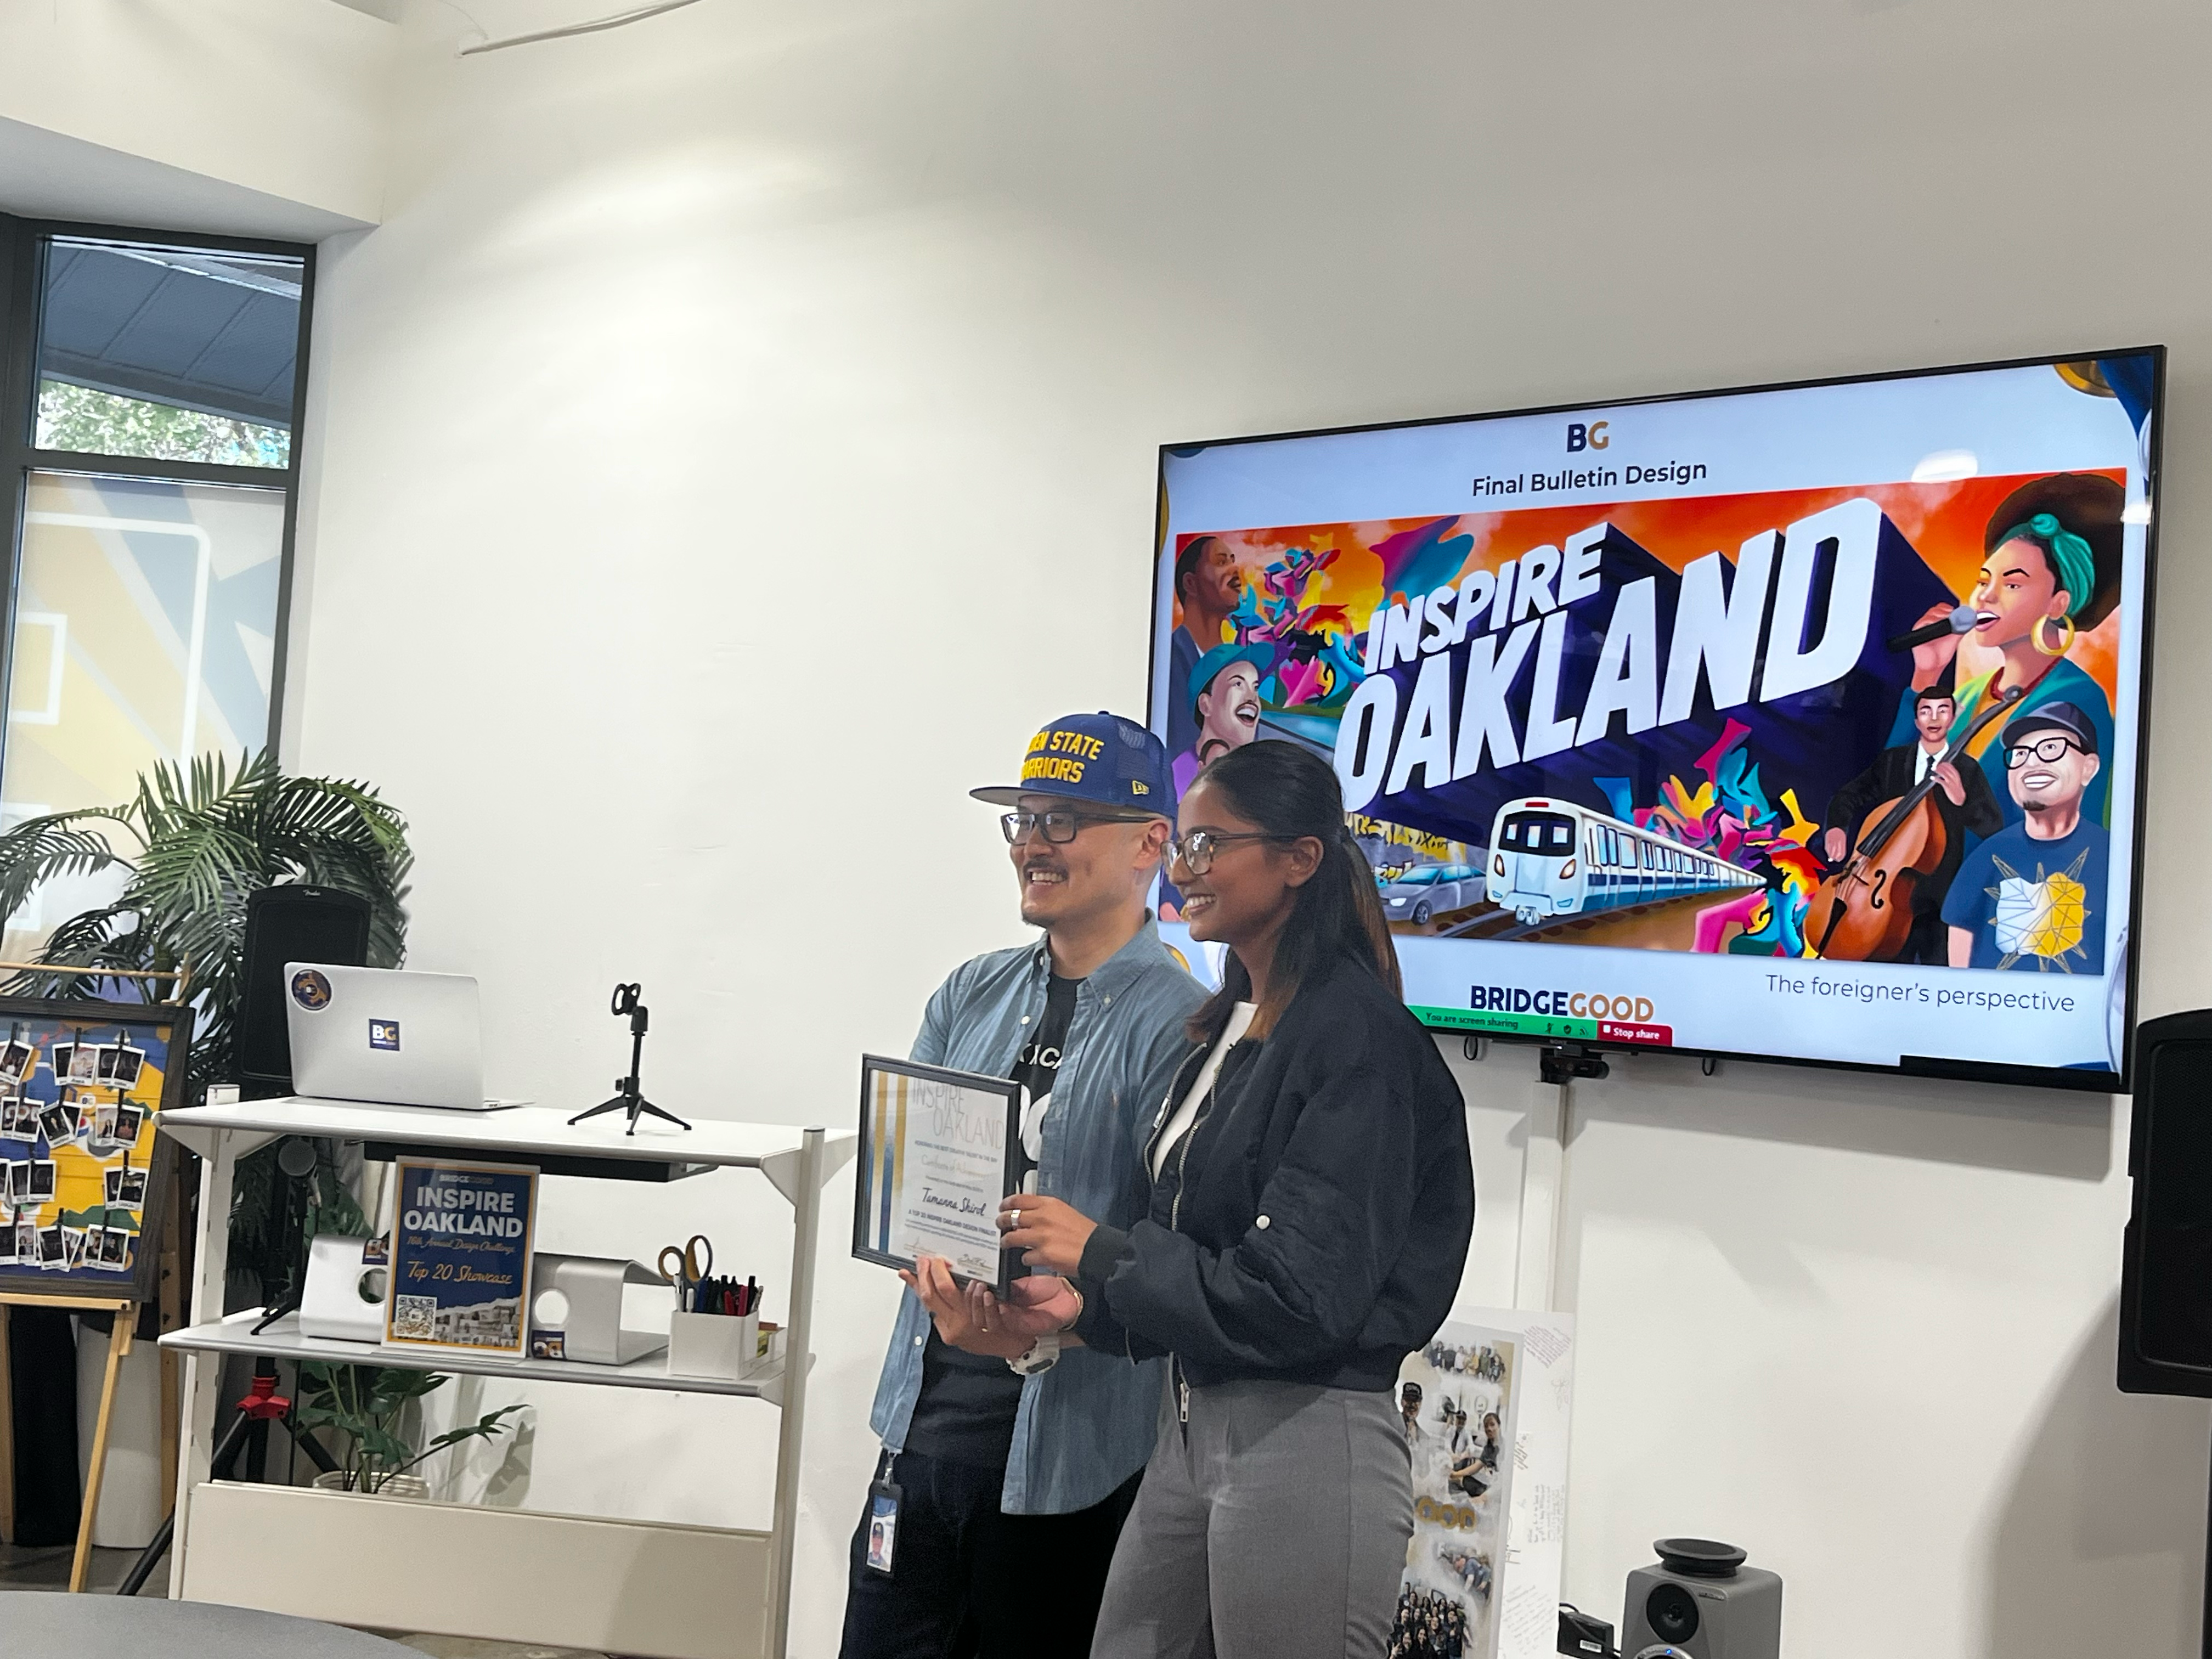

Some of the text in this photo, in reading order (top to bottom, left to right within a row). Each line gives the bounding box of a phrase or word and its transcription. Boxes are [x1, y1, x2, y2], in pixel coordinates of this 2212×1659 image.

[1567, 421, 1609, 453] BG
[1472, 460, 1707, 496] Final Bulletin Design
[1364, 521, 1610, 675] INSPIRE
[1333, 498, 1882, 812] OAKLAND
[1049, 730, 1105, 761] STATE
[1470, 985, 1654, 1022] BRIDGEGOOD
[1766, 974, 1805, 994] The
[1937, 987, 2075, 1012] perspective
[1426, 1012, 1442, 1022] You
[1459, 1017, 1486, 1025] screen
[1487, 1017, 1519, 1030] sharing
[1613, 1027, 1660, 1040] Stop share
[912, 1077, 964, 1116] INSPIRE
[933, 1107, 1005, 1149] OAKLAND
[416, 1186, 515, 1213] INSPIRE
[404, 1210, 523, 1238] OAKLAND
[407, 1260, 514, 1285] Top 20 Showcase
